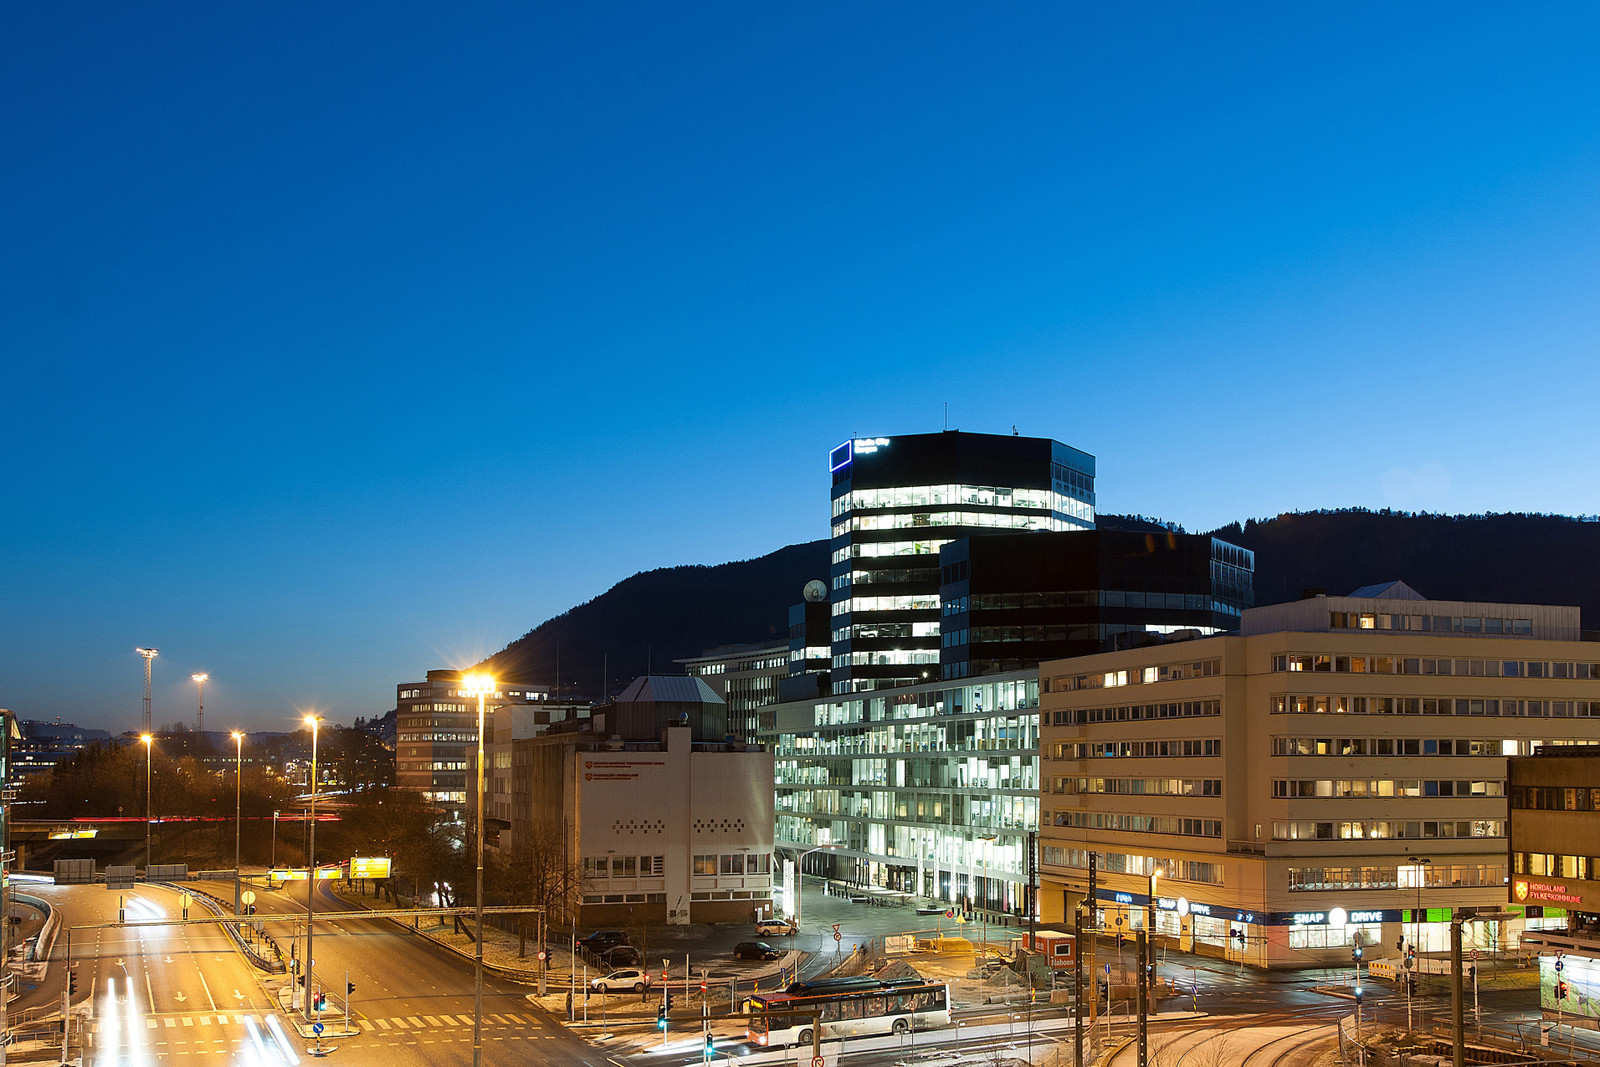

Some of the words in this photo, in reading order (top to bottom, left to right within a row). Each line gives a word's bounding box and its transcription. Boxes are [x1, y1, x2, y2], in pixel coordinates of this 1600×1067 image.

[1530, 883, 1566, 894] HORDALAND
[1530, 892, 1582, 904] FYLKESKOMMUNE
[1158, 898, 1177, 910] SNAP
[1190, 903, 1211, 915] DRIVE
[1293, 912, 1324, 924] SNAP
[1351, 911, 1383, 922] DRIVE
